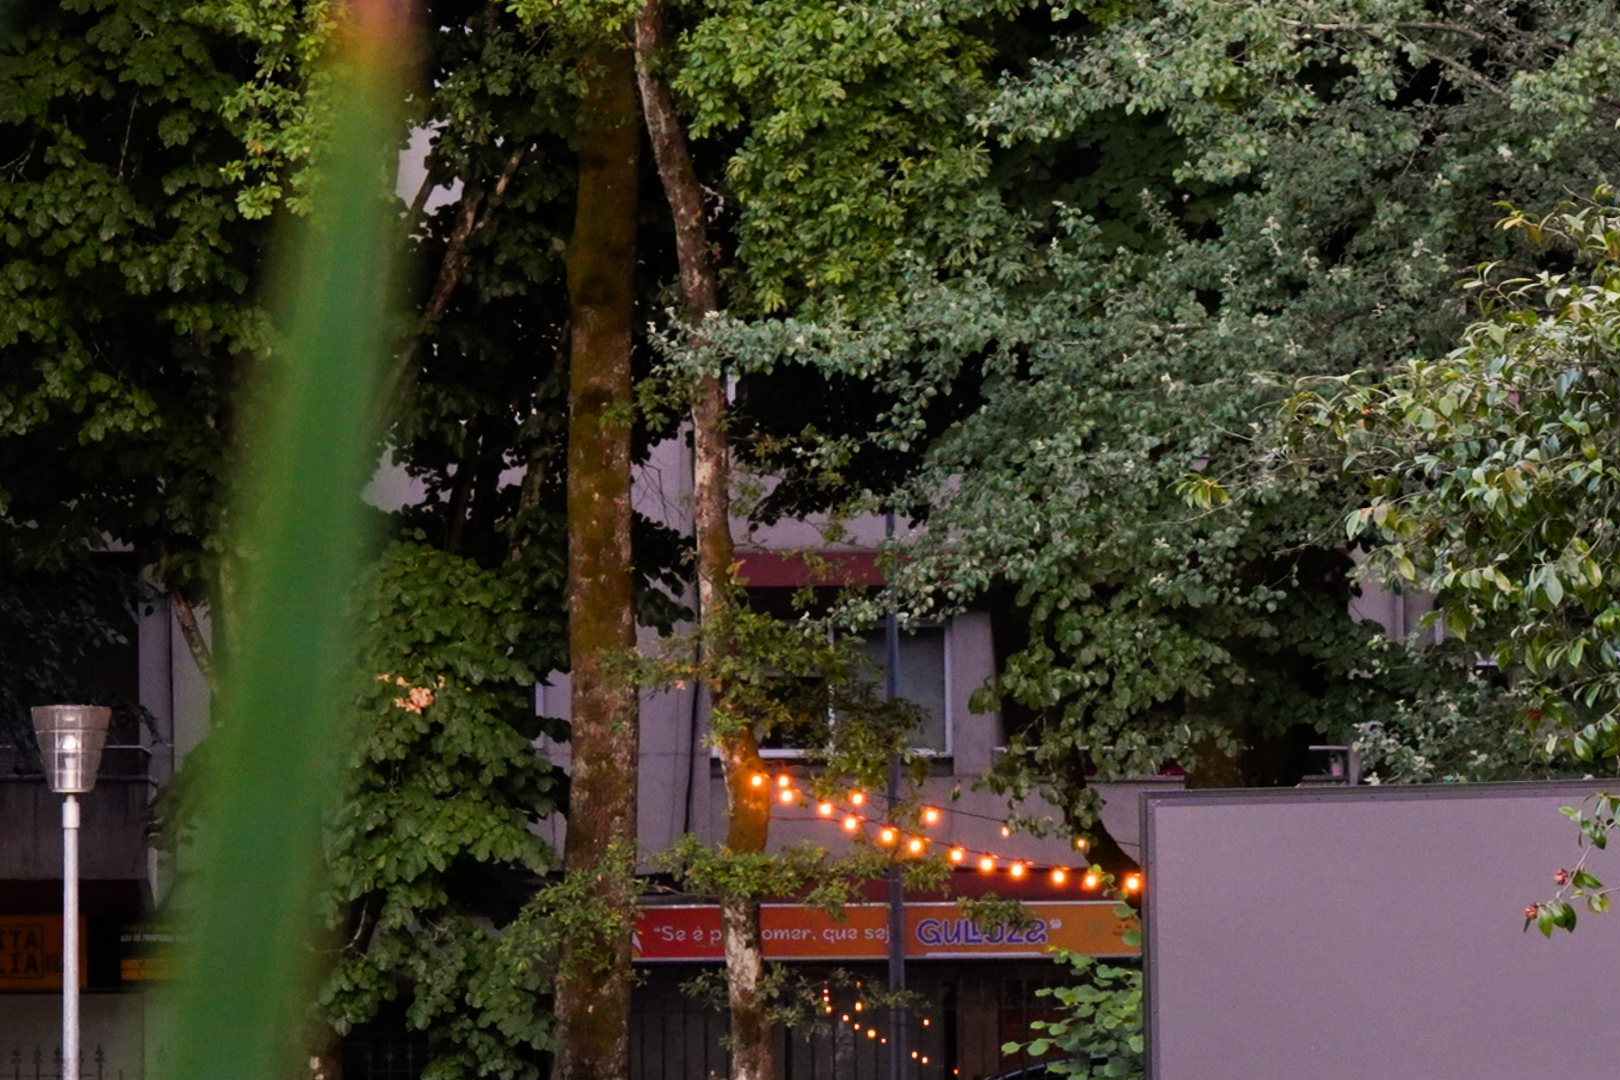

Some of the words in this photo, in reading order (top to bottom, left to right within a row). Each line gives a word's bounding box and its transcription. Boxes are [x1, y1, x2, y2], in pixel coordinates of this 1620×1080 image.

[761, 928, 817, 942] omer,
[822, 928, 858, 944] que
[864, 924, 890, 944] sej
